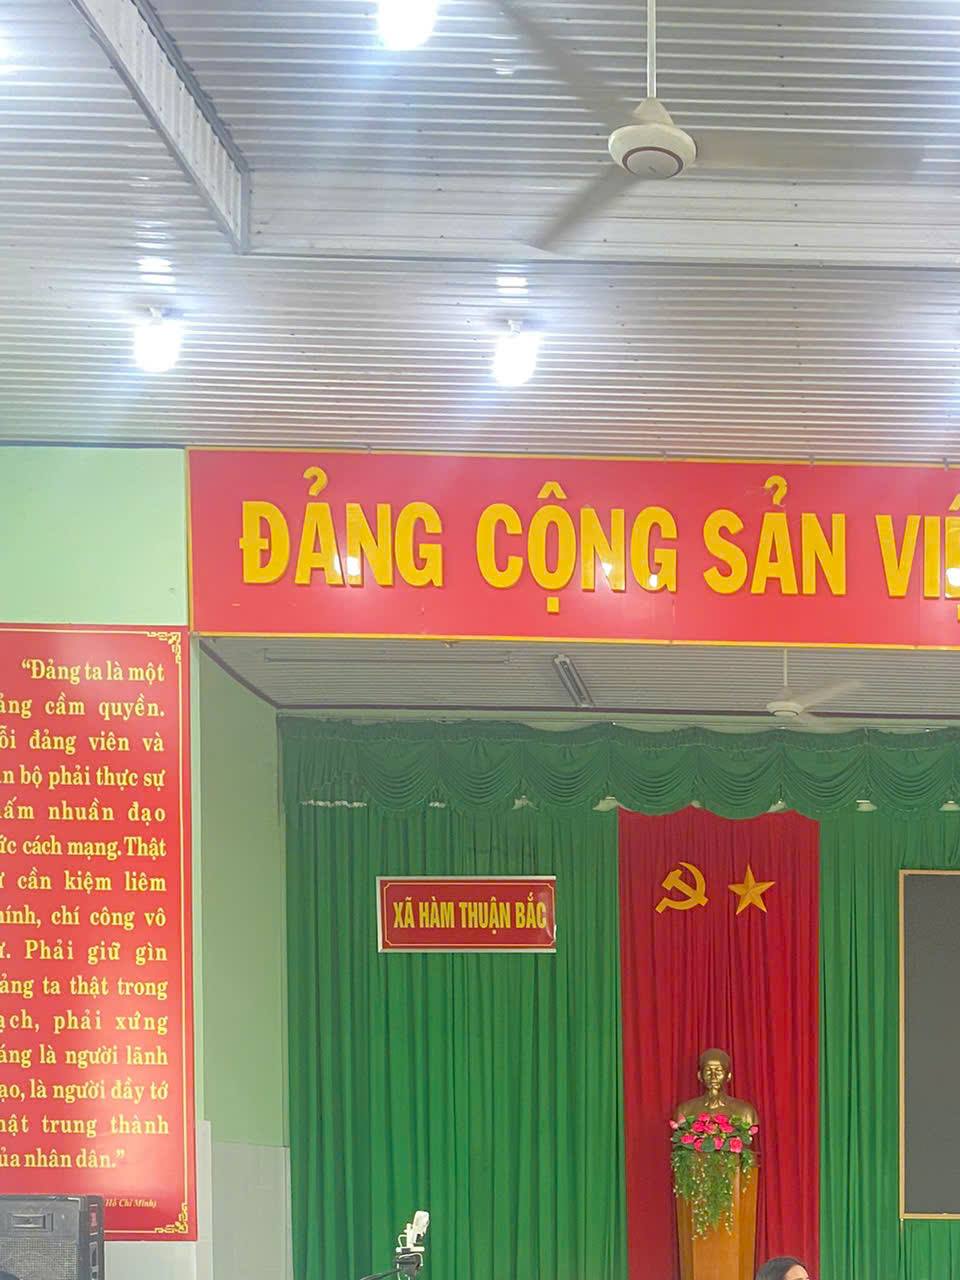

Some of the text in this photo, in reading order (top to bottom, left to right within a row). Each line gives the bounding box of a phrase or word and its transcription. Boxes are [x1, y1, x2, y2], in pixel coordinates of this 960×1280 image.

[239, 466, 443, 587] ĐẢNG
[475, 481, 677, 613] CỘNG
[702, 475, 847, 595] SẢN
[84, 661, 103, 681] ta
[106, 660, 124, 682] là
[128, 663, 165, 684] một
[45, 691, 86, 716] cầm
[98, 692, 165, 721] quyền.
[29, 728, 77, 755] đảng
[88, 731, 130, 751] viên
[142, 733, 164, 752] và
[0, 764, 166, 792] n bộ phải thực sự
[0, 796, 166, 826] ấm nhuần đạo
[22, 834, 63, 856] cách
[67, 840, 122, 861] mạng.
[123, 835, 167, 859] Thật
[17, 866, 52, 891] cần
[63, 869, 112, 895] kiệm
[124, 869, 167, 892] liêm
[51, 905, 80, 926] chí
[90, 905, 135, 932] công
[144, 906, 167, 927] vô
[393, 892, 547, 935] XÃ HÀM THUẬN BẮC
[24, 938, 74, 961] Phải
[87, 941, 121, 966] giữ
[135, 941, 168, 966] gìn
[42, 976, 61, 995] ta
[69, 974, 109, 998] thật
[117, 976, 169, 1000] trong
[53, 1009, 102, 1035] phải
[115, 1010, 169, 1035] xứng
[39, 1043, 57, 1065] là
[64, 1046, 118, 1069] người
[126, 1045, 169, 1066] lãnh
[29, 1078, 48, 1099] là
[52, 1080, 106, 1104] người
[111, 1079, 145, 1104] đầy
[149, 1081, 169, 1100] tớ
[42, 1115, 97, 1138] trung
[111, 1115, 169, 1136] thành
[24, 1147, 73, 1169] nhân
